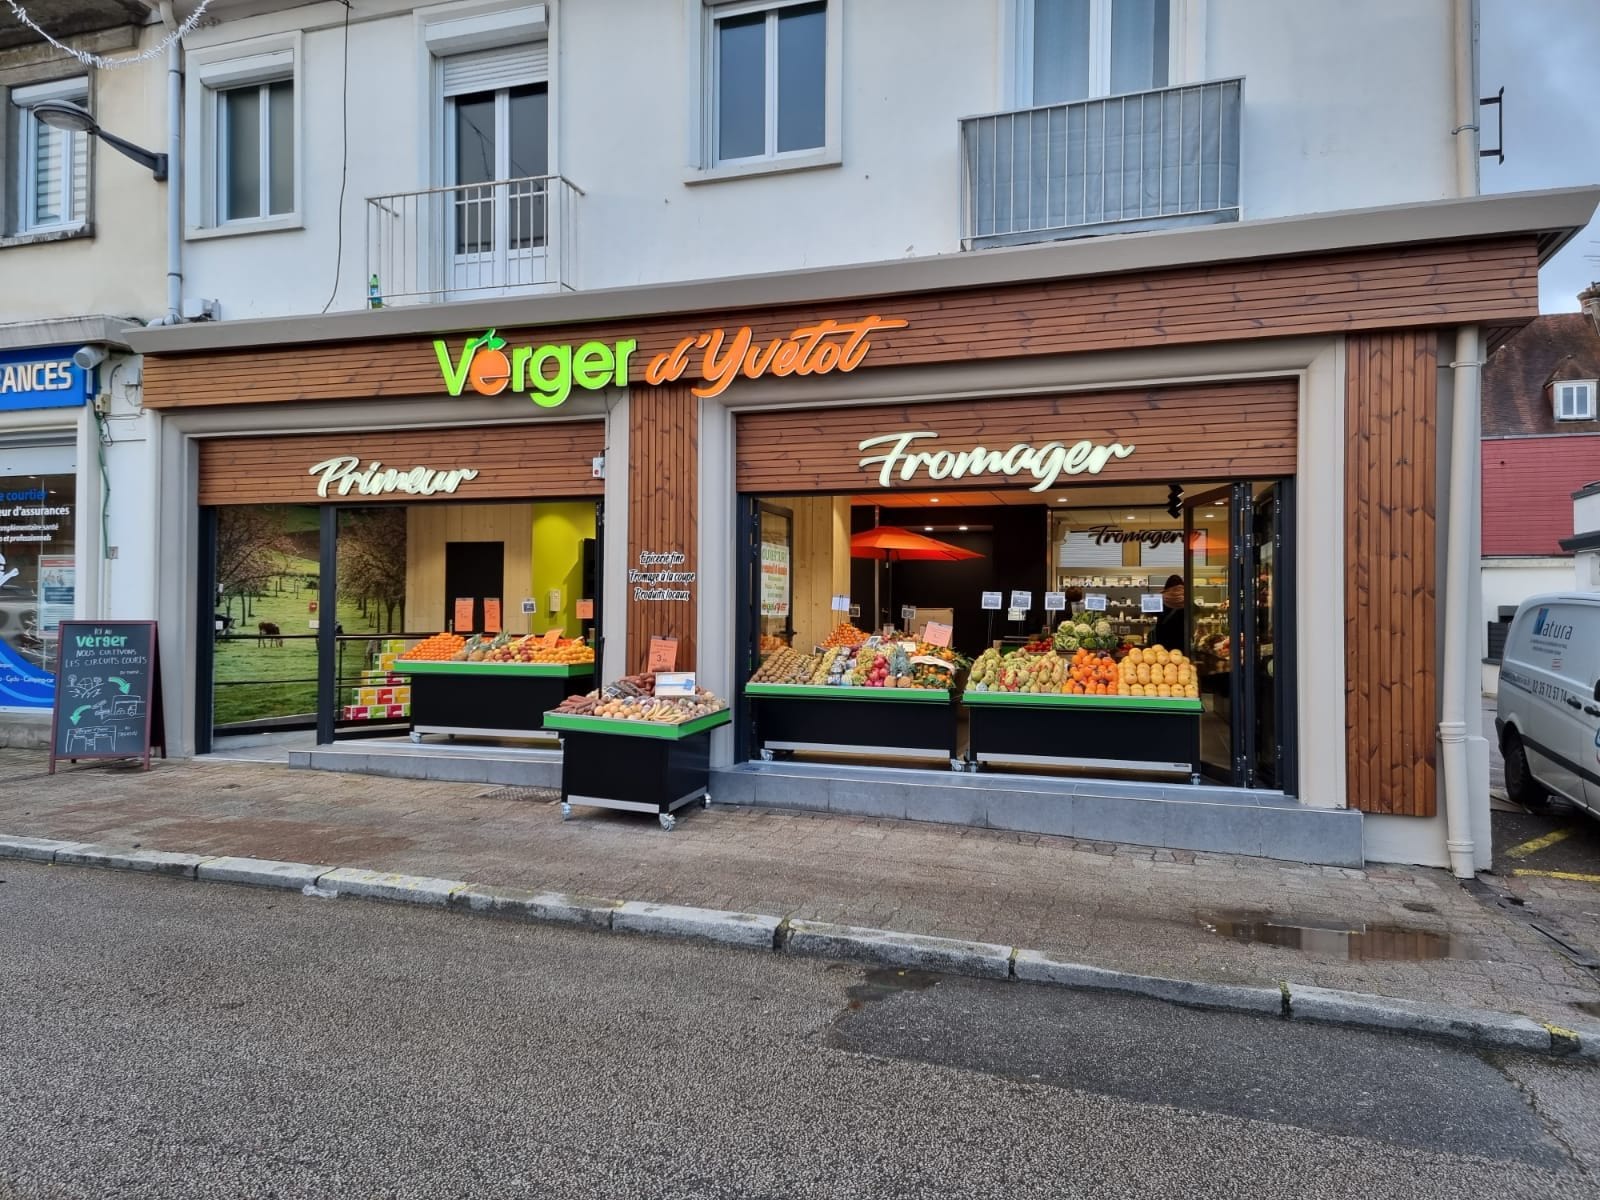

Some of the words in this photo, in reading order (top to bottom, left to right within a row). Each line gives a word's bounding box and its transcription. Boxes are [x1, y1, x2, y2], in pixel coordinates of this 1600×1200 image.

[432, 329, 637, 408] Verger
[644, 315, 910, 398] d'Yvetot
[0, 361, 72, 394] ANCES
[857, 431, 1136, 493] Fromager
[308, 455, 479, 498] Primeur
[12, 505, 70, 517] d'assurances
[634, 587, 665, 602] Produits
[665, 588, 690, 602] locaux
[65, 658, 80, 668] LES
[84, 657, 120, 666] CIRCUITS
[76, 649, 95, 657] NOUS
[99, 648, 137, 656] CULTIVONS
